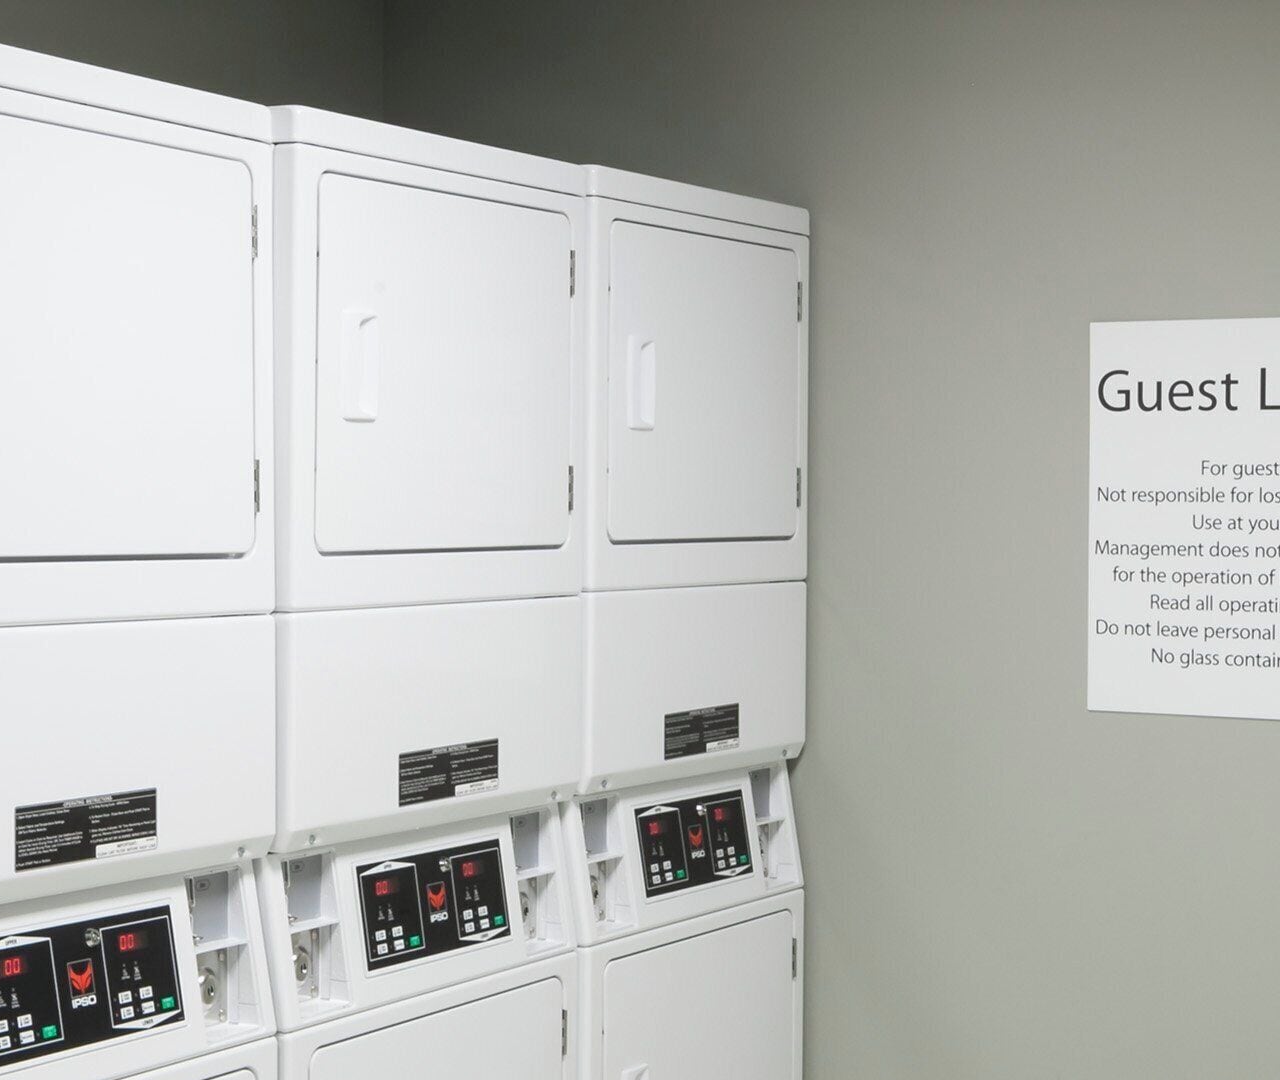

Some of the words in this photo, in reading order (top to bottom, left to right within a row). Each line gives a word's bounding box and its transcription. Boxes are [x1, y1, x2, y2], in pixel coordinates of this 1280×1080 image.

[1098, 370, 1238, 411] Guest
[1202, 460, 1227, 476] For
[1233, 463, 1279, 480] guest
[1098, 487, 1126, 502] Not
[1132, 487, 1225, 506] responsible
[1231, 487, 1253, 503] for
[1193, 515, 1222, 530] Use
[1228, 517, 1243, 530] at
[1095, 540, 1203, 560] Management
[1209, 541, 1249, 557] does
[1113, 566, 1135, 582] for
[1140, 567, 1166, 583] the
[1172, 571, 1252, 587] operation
[1258, 569, 1275, 585] of
[1151, 594, 1189, 610] Read
[1196, 595, 1212, 611] all
[1096, 619, 1118, 635] Do
[1125, 623, 1151, 636] not
[1157, 621, 1198, 638] leave
[1204, 625, 1275, 642] personal
[1152, 648, 1174, 663] No
[1180, 649, 1219, 668] glass
